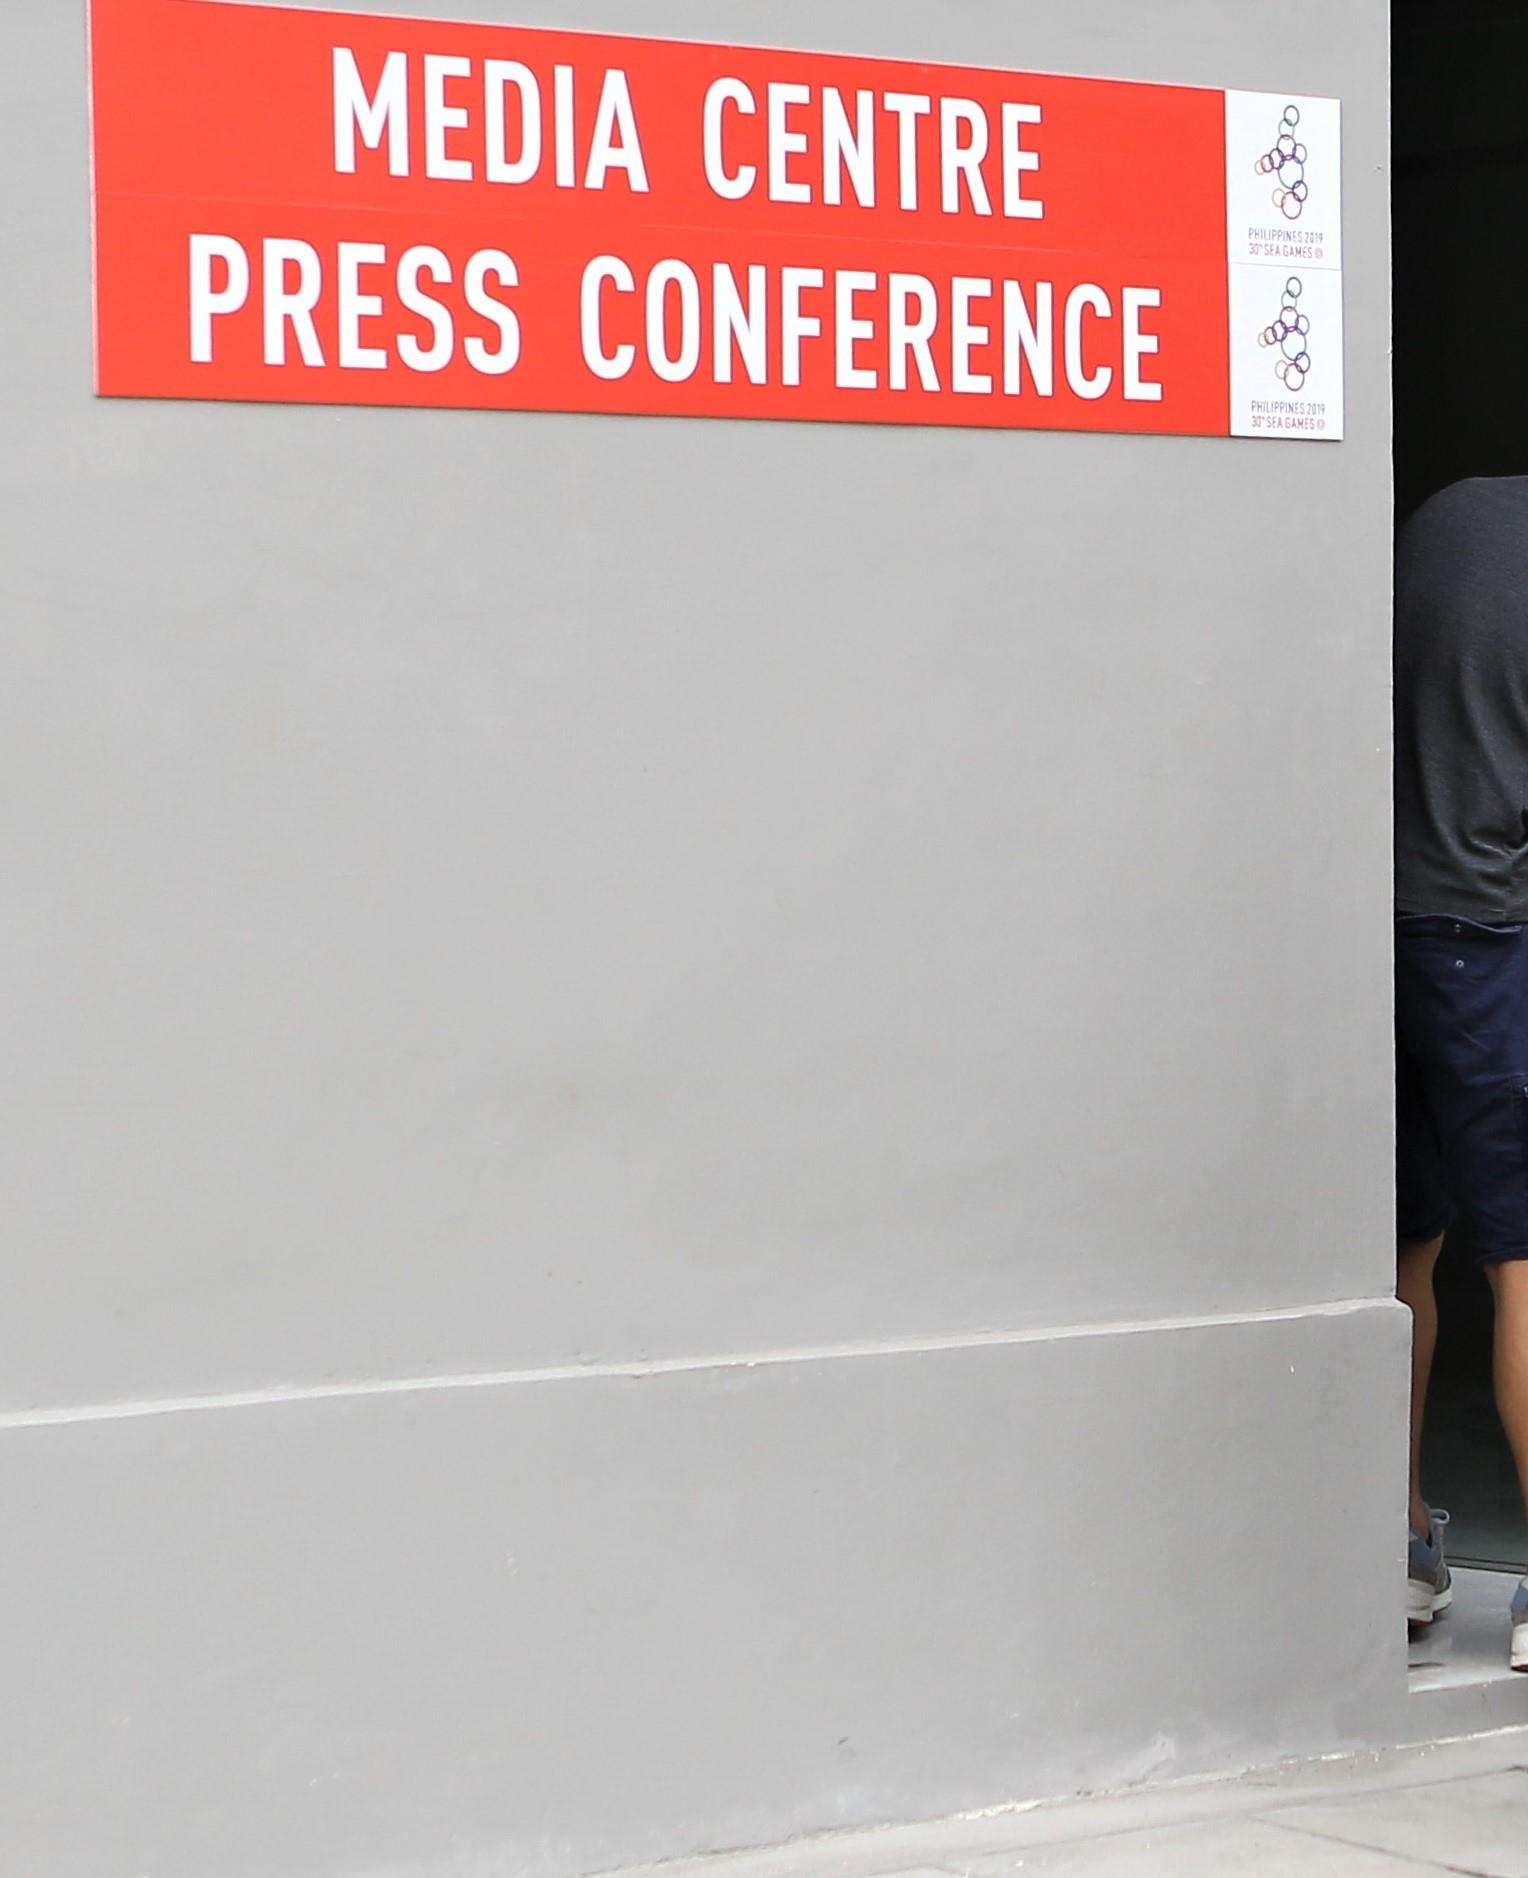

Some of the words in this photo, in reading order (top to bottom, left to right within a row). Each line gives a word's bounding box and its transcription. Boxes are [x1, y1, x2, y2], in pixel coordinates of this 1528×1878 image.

[331, 46, 649, 194] MEDIA
[703, 77, 1044, 220] CENTRE
[1248, 227, 1303, 243] PHILIPPINES
[1304, 231, 1323, 244] 2019
[1264, 243, 1281, 256] SEA
[1282, 244, 1313, 259] GAMES
[189, 233, 520, 376] PRESS
[580, 255, 1163, 402] CONFERENCE
[1251, 400, 1305, 415] PHILIPPINES
[1306, 402, 1325, 416] 2019
[1266, 415, 1283, 429] SEA
[1284, 416, 1315, 430] GAMES
